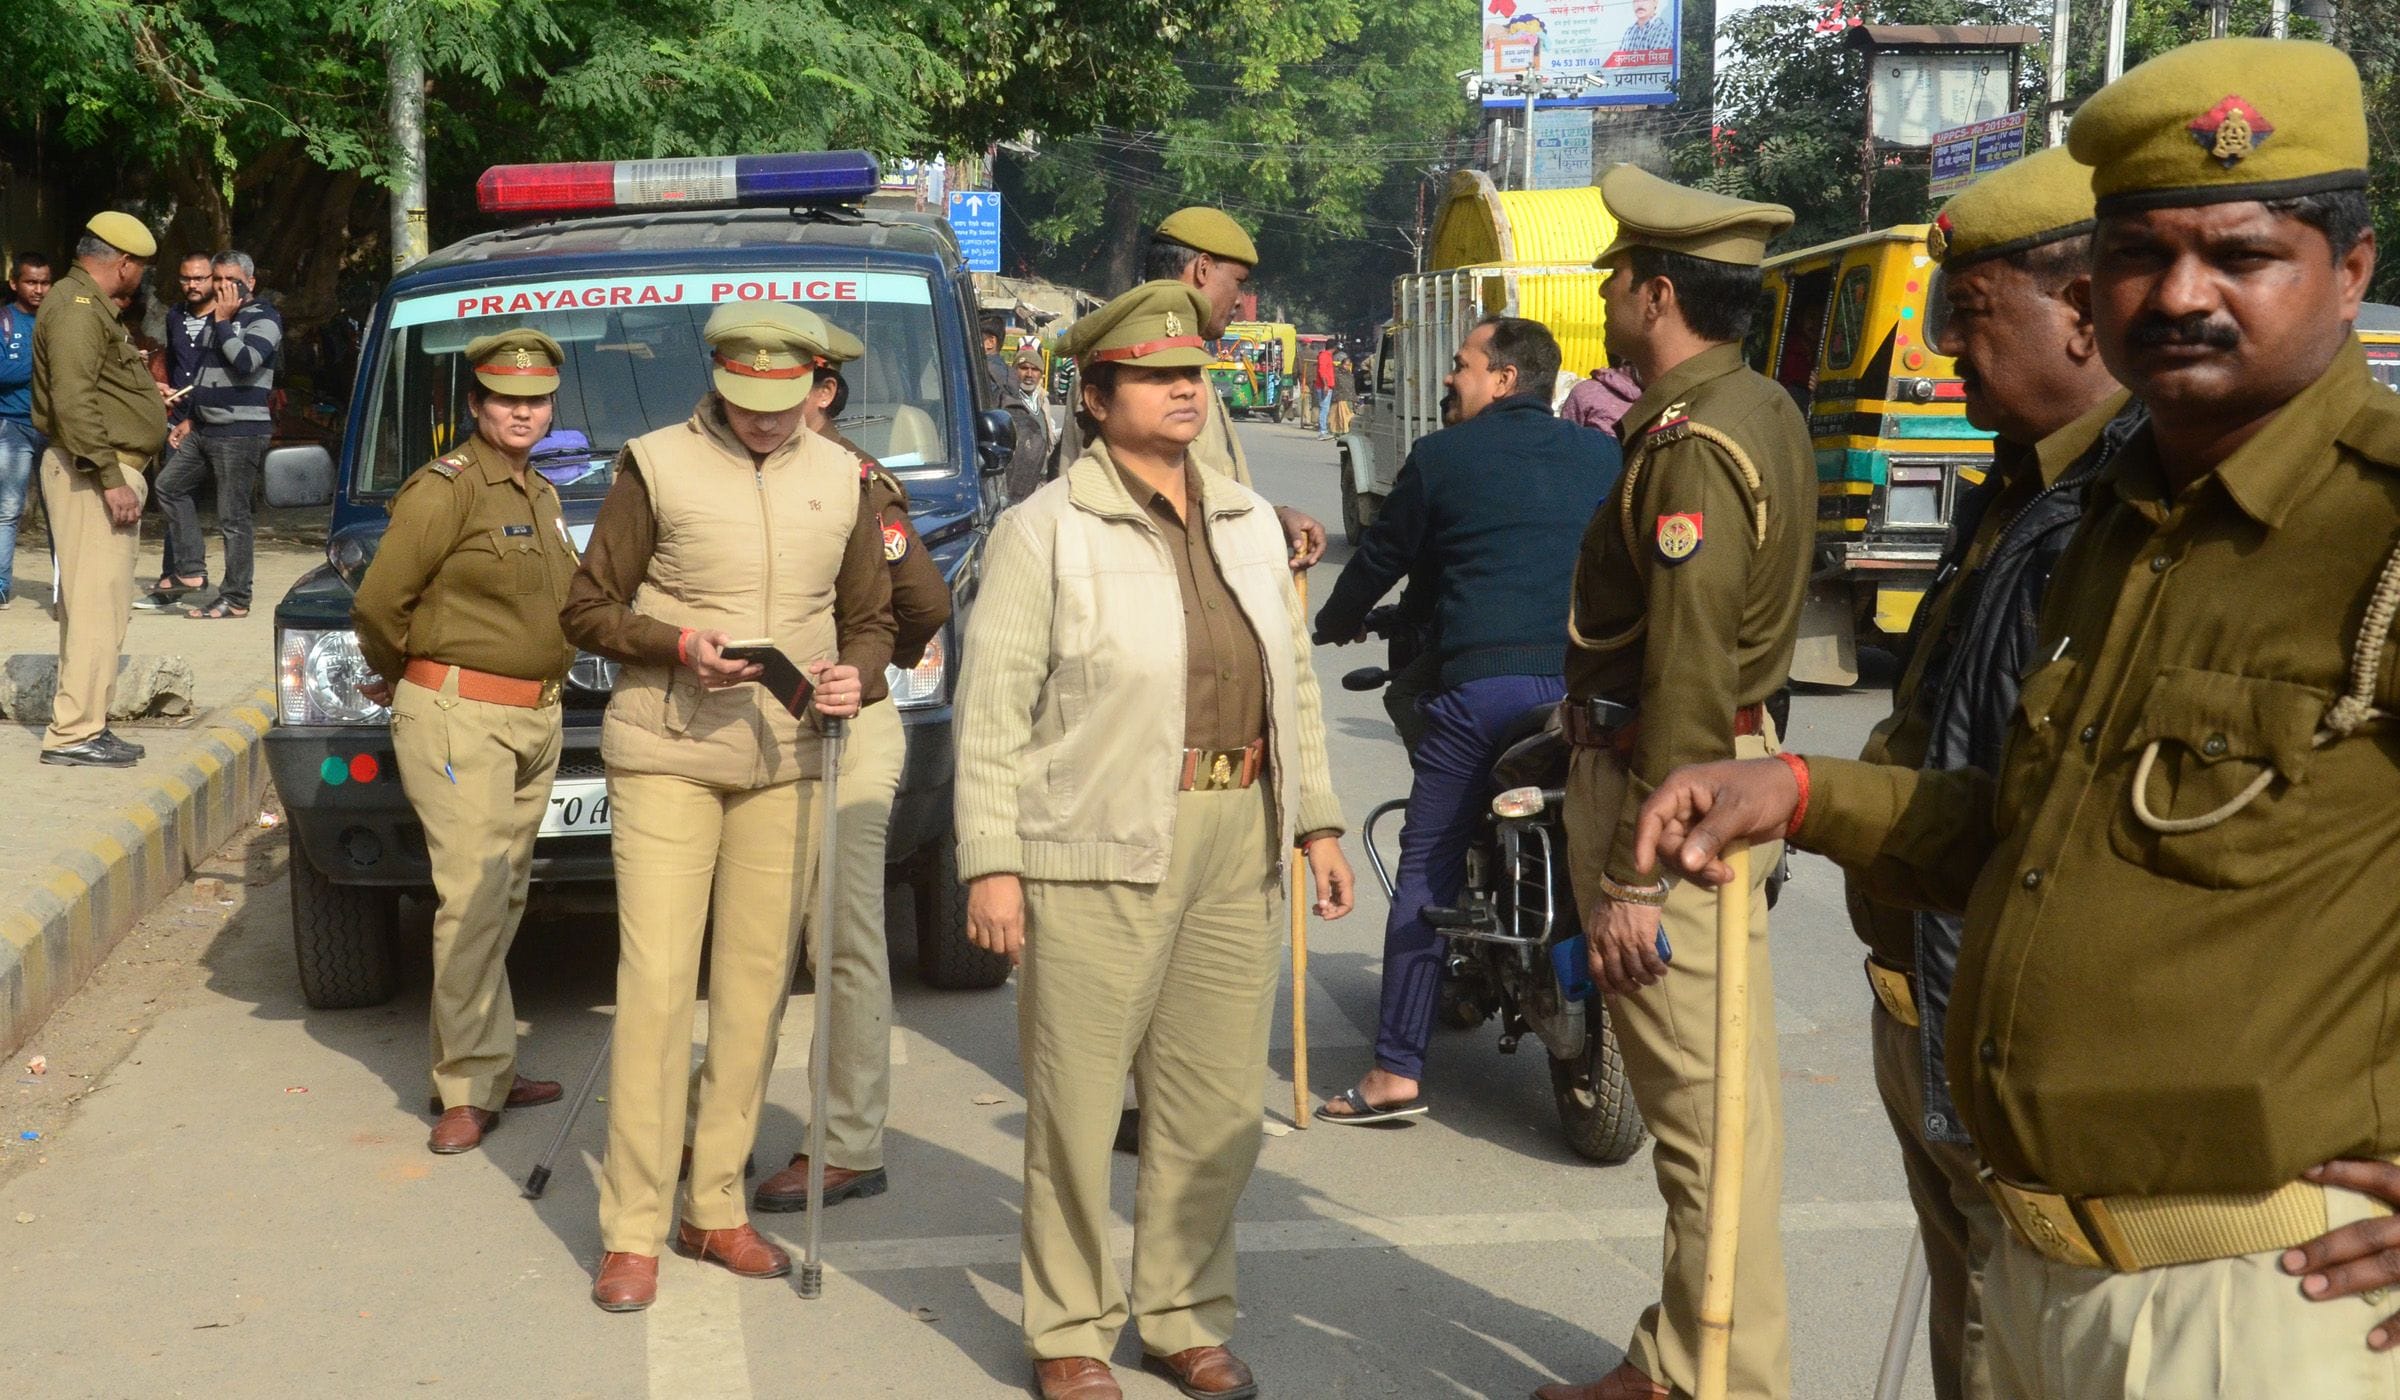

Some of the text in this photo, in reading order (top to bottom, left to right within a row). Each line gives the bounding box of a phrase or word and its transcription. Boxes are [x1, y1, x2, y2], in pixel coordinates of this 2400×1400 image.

[1614, 72, 1670, 87] प्रयागराज
[457, 281, 858, 318] PRAYAGRAJ POLICE
